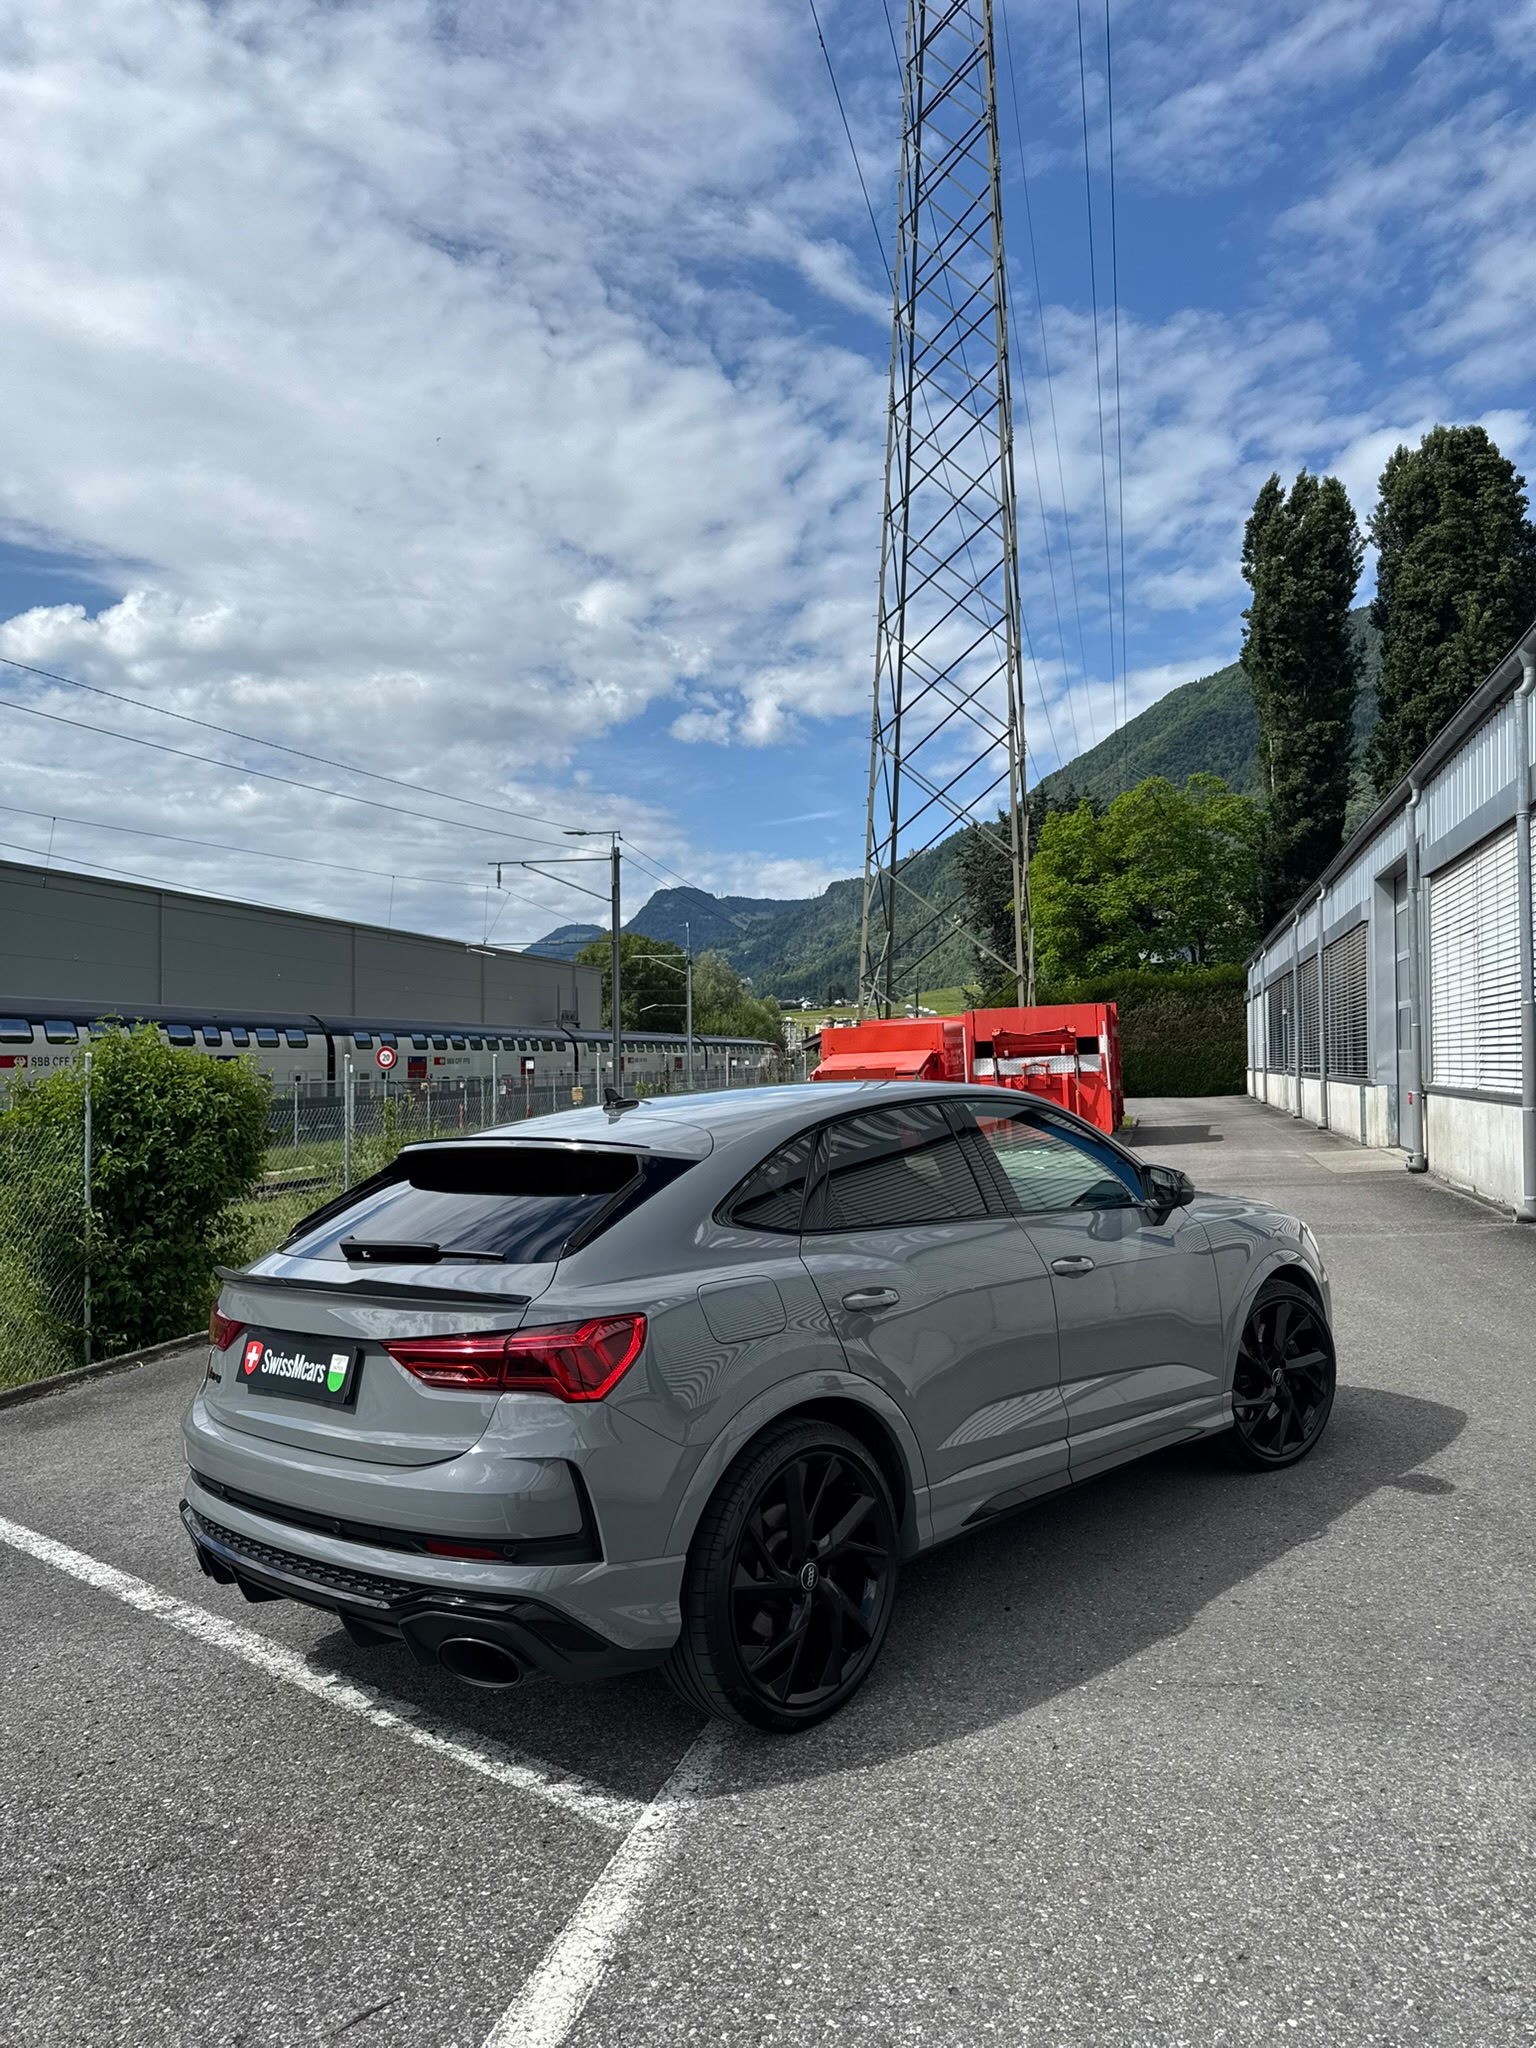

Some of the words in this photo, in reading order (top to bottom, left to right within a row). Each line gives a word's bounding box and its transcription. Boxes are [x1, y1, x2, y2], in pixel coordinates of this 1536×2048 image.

[31, 1056, 50, 1067] SBB
[382, 1053, 391, 1062] 20
[261, 1348, 326, 1383] SwissMcars
